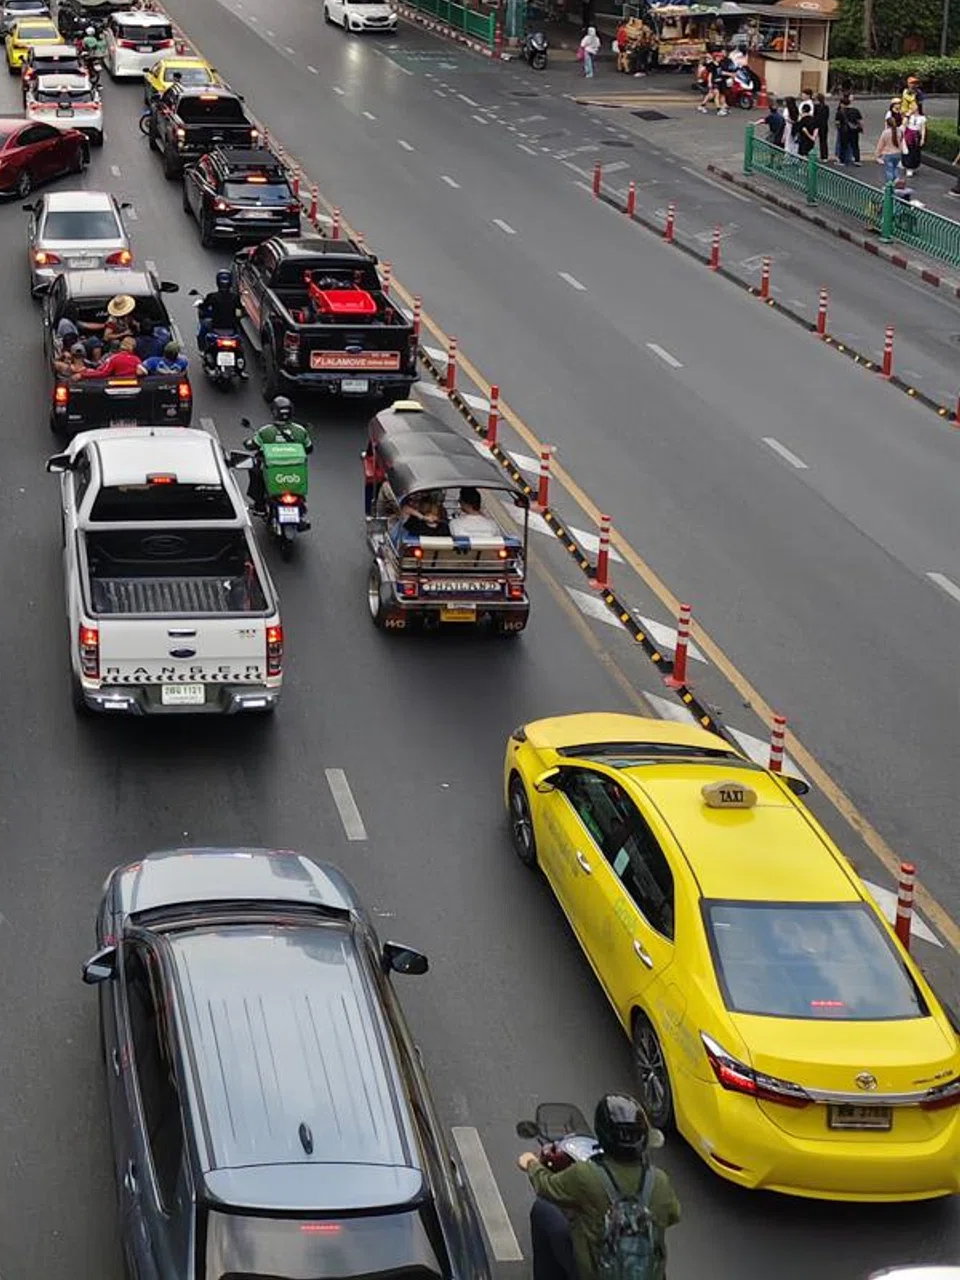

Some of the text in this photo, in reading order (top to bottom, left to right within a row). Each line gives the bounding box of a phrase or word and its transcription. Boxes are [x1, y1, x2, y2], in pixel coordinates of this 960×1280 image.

[275, 474, 300, 483] Grab
[106, 665, 260, 675] RANGER
[719, 790, 743, 803] TAXI
